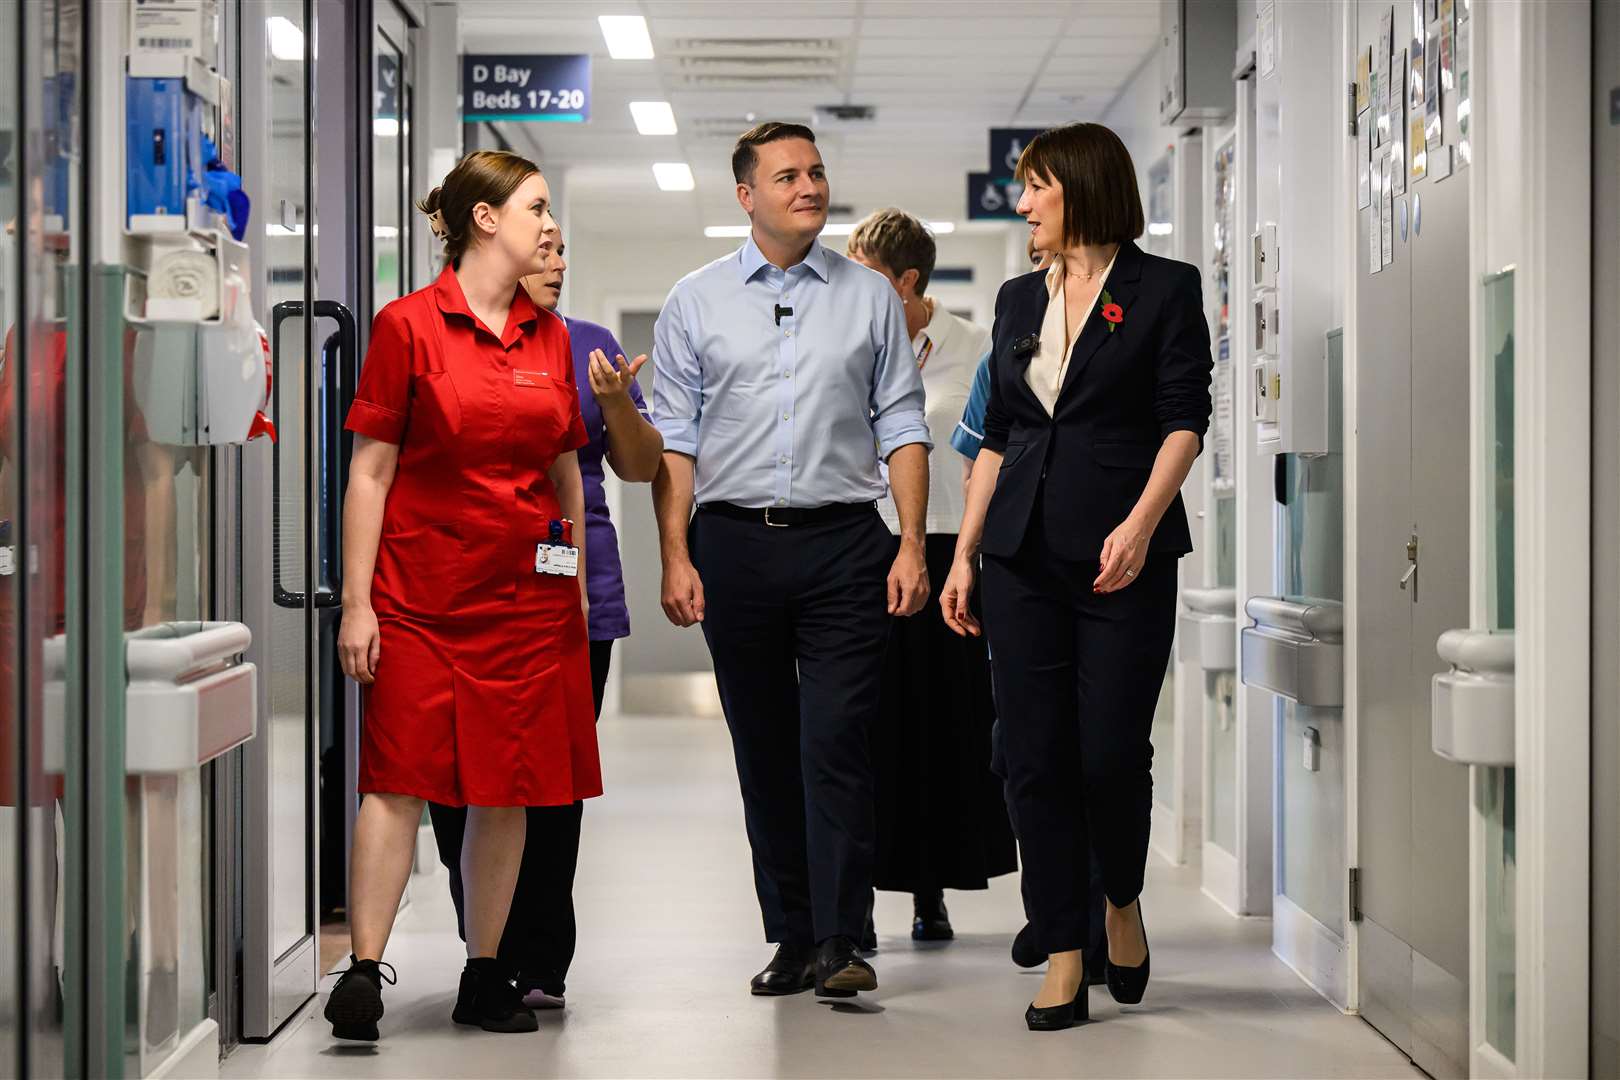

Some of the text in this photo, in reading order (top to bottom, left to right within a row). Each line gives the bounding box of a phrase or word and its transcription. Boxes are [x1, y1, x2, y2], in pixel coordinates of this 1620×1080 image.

[472, 65, 532, 87] D Bay
[472, 89, 585, 109] Beds 17-20
